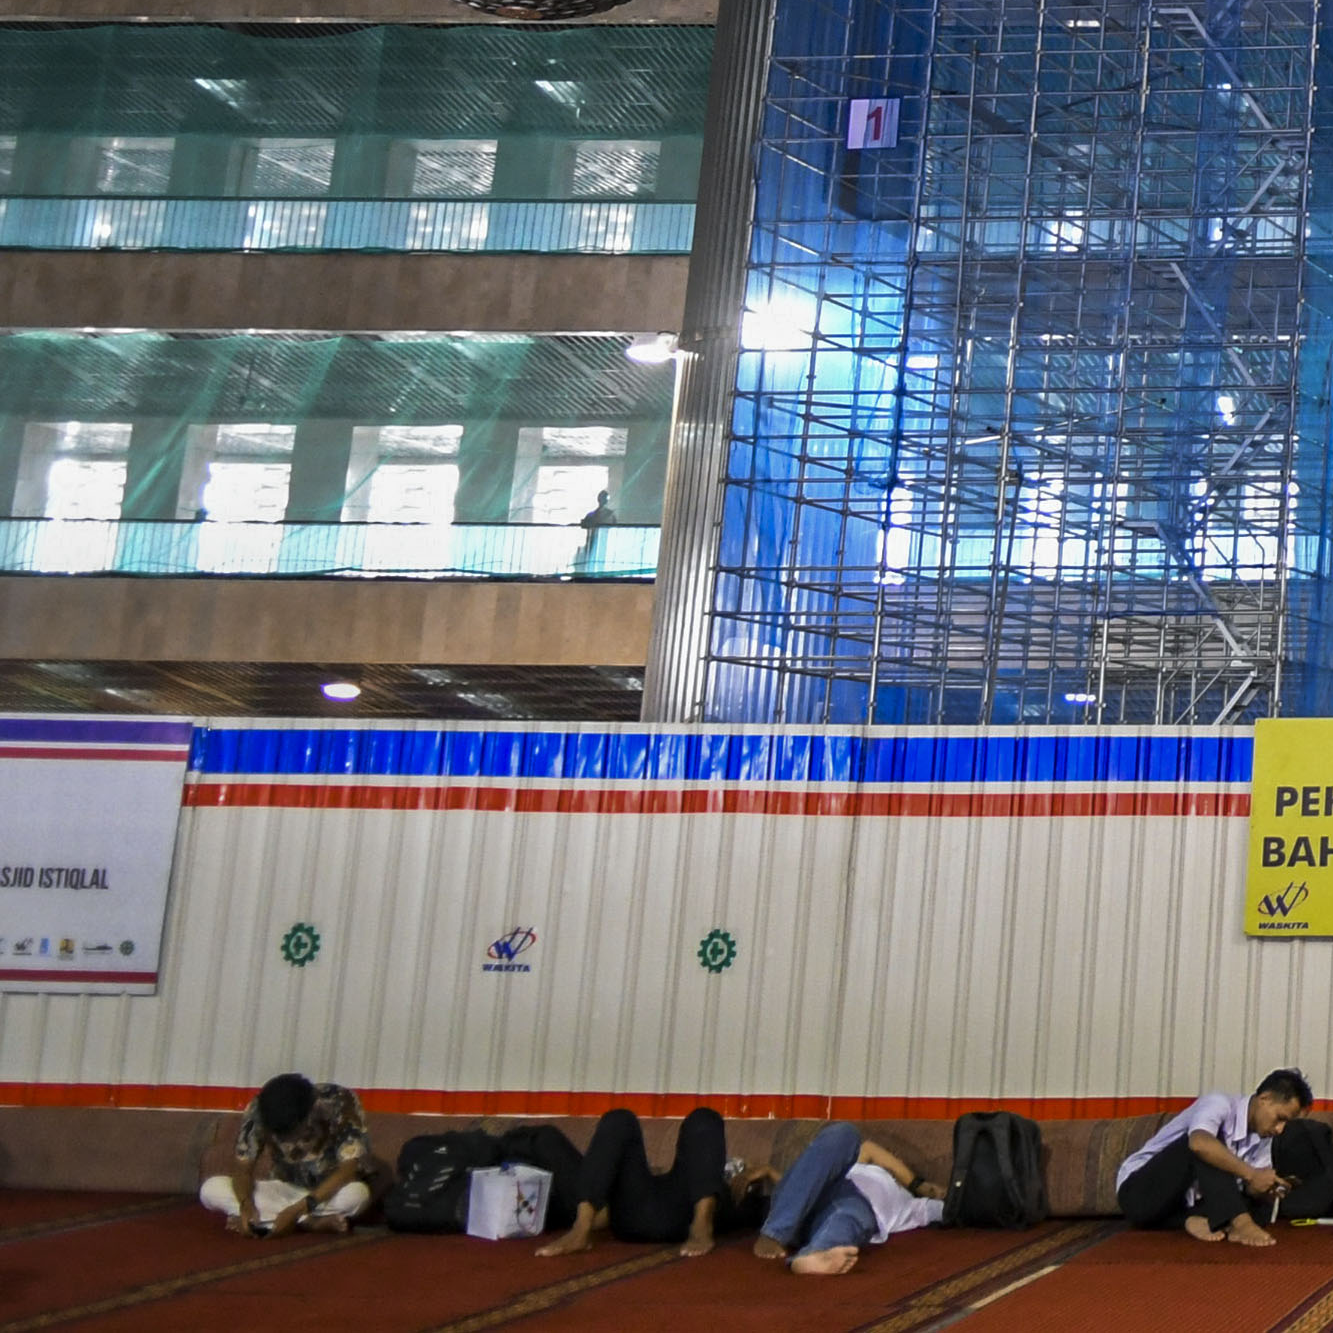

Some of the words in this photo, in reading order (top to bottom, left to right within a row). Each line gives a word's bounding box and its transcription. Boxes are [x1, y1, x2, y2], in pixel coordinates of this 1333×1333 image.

[867, 106, 883, 141] 1
[39, 867, 109, 890] ISTIQLAL
[1257, 921, 1309, 930] WASKITA
